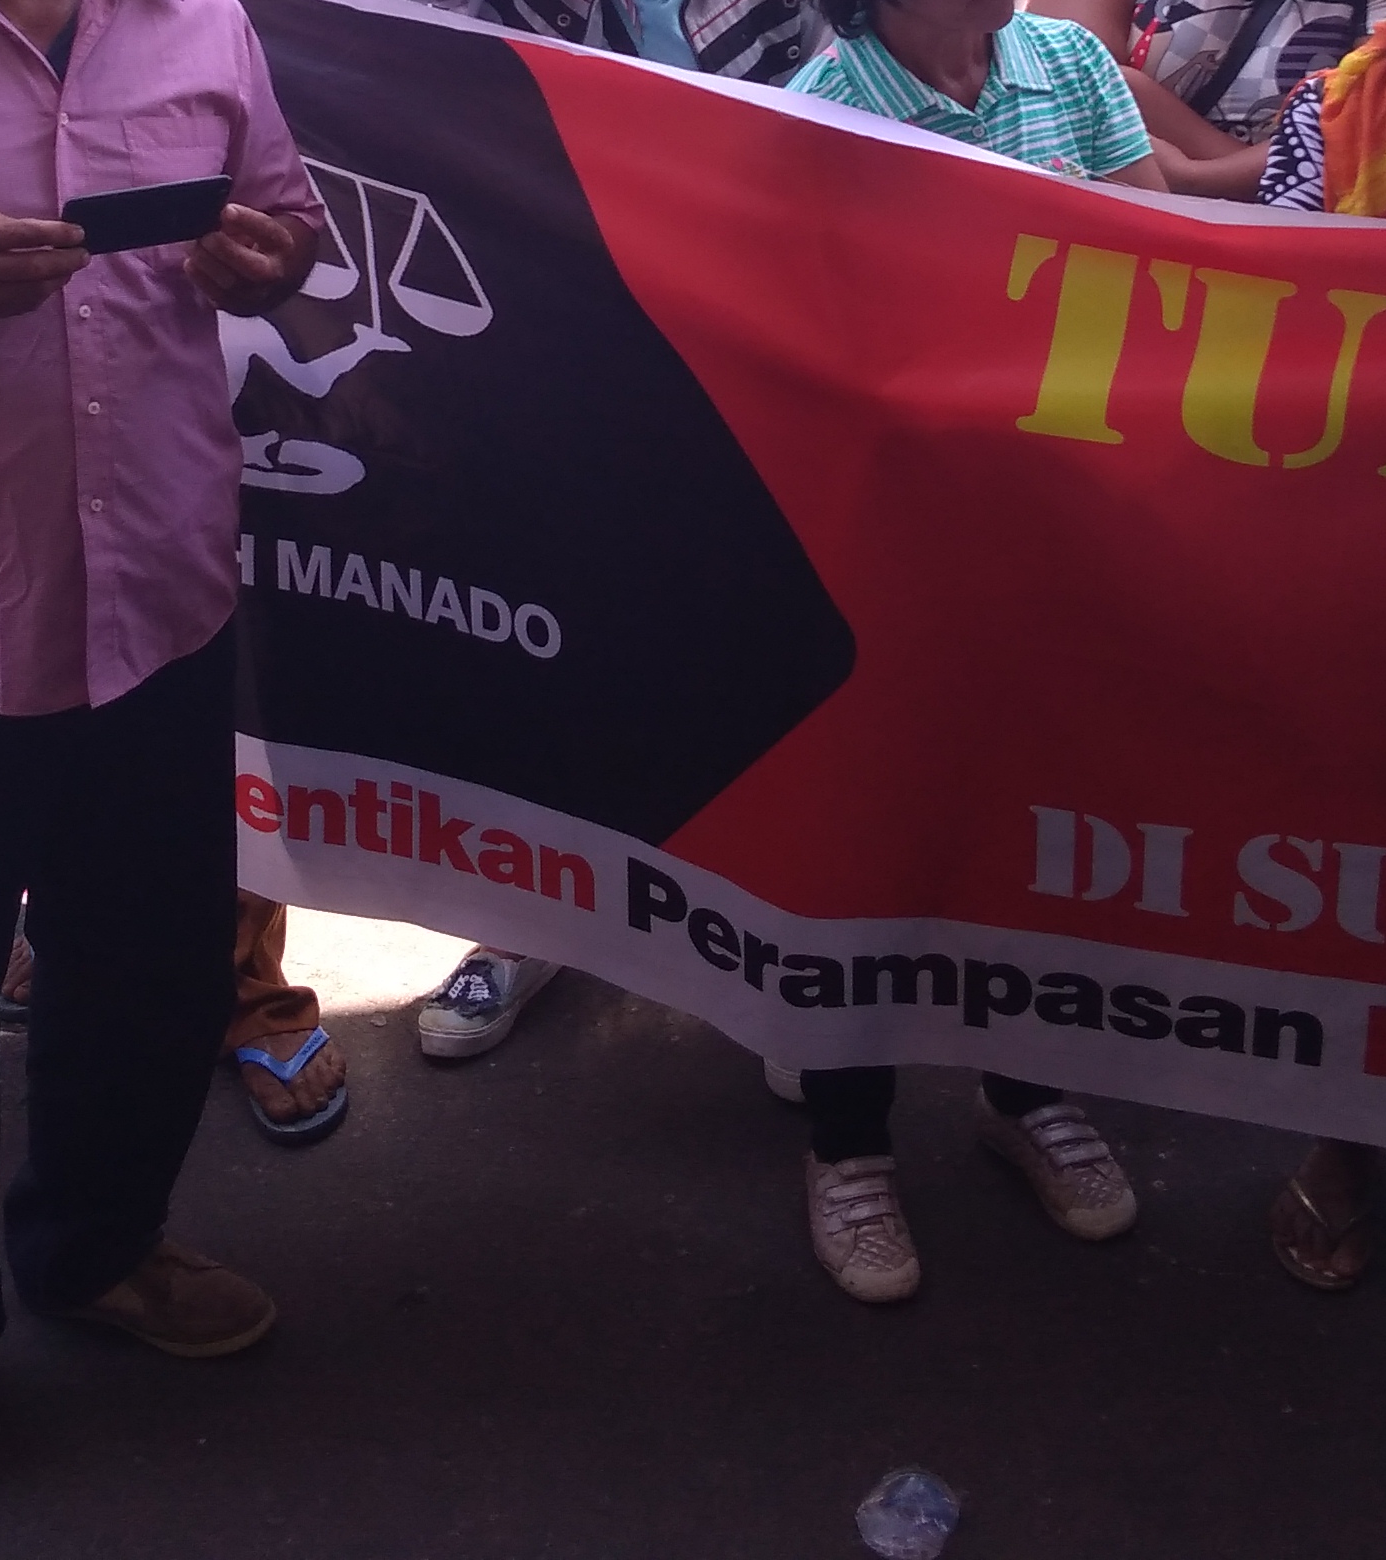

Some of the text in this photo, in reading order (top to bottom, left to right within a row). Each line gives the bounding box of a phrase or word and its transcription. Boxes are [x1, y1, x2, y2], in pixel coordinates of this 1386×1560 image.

[276, 538, 563, 660] MANADO
[235, 772, 597, 913] entikan
[625, 856, 1325, 1068] Perampasan
[1029, 803, 1194, 918] DI
